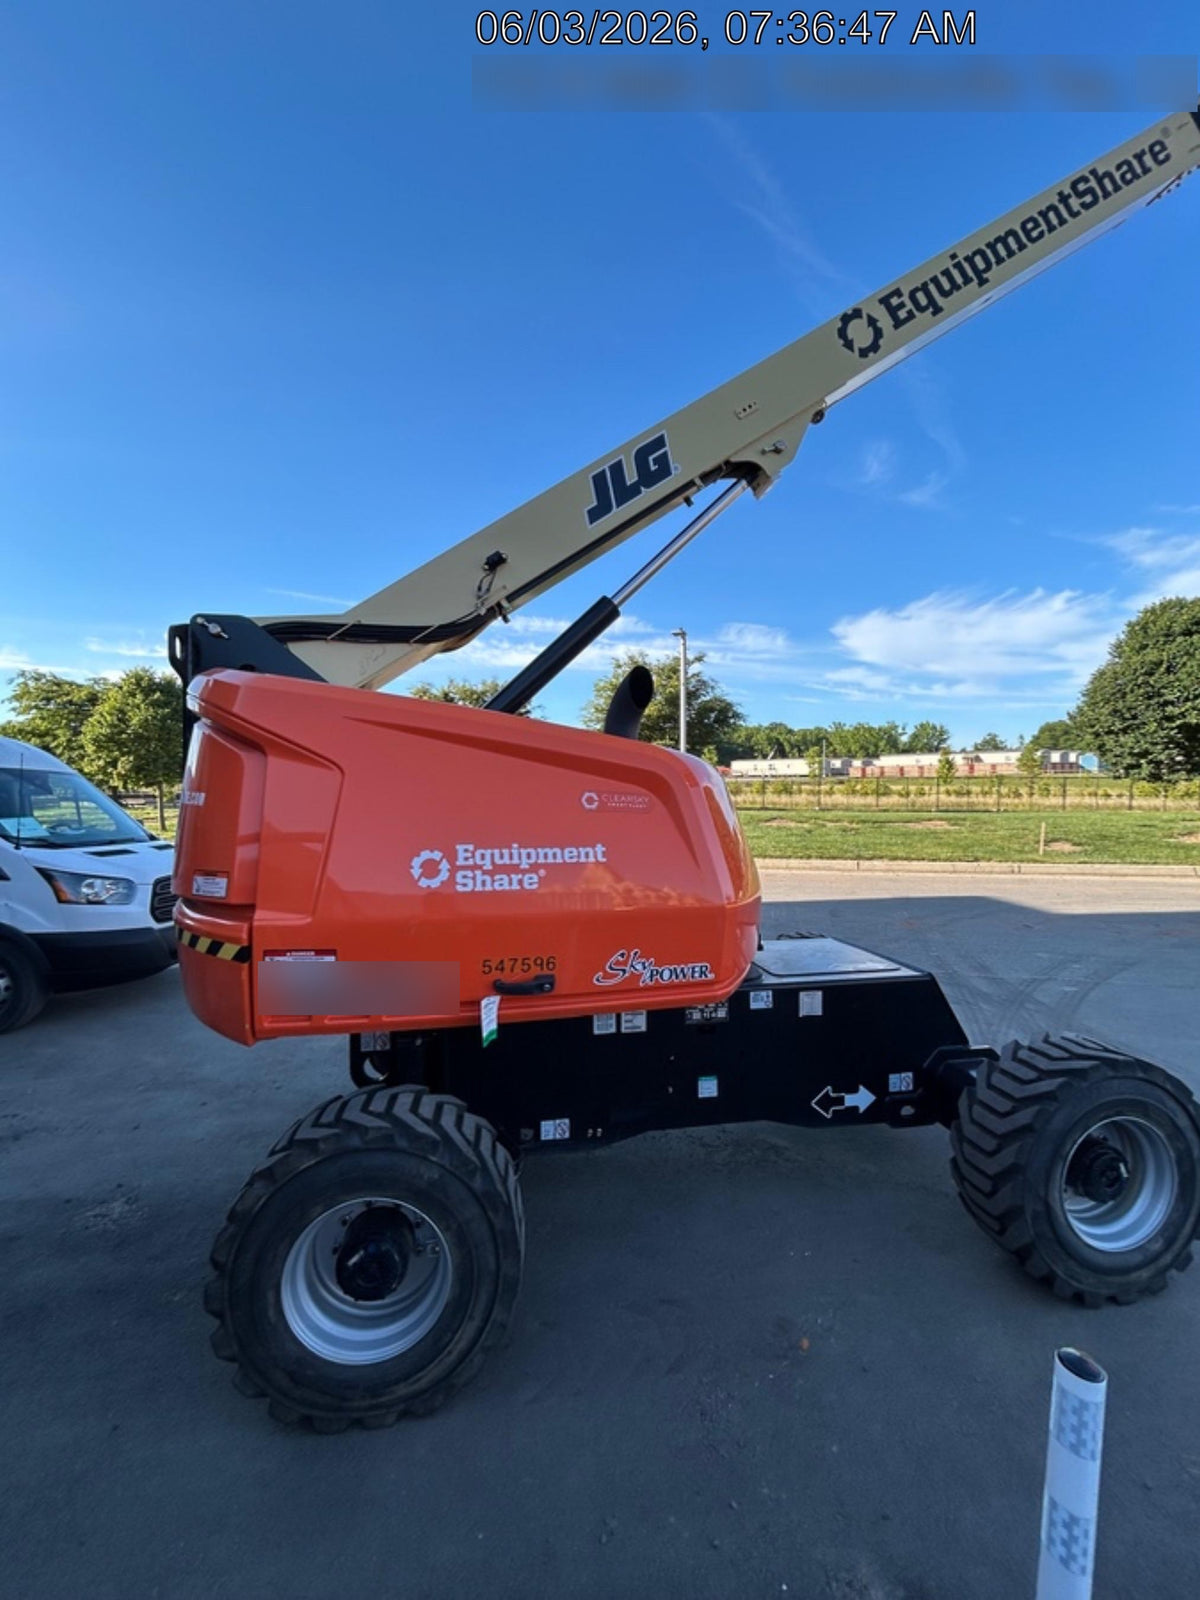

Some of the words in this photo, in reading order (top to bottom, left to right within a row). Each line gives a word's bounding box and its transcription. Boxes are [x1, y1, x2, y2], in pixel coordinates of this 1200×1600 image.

[878, 139, 1171, 330] EquipmentShare
[583, 430, 675, 528] JLG
[455, 843, 607, 870] Equipment
[455, 868, 539, 892] Share
[481, 955, 557, 975] 547596
